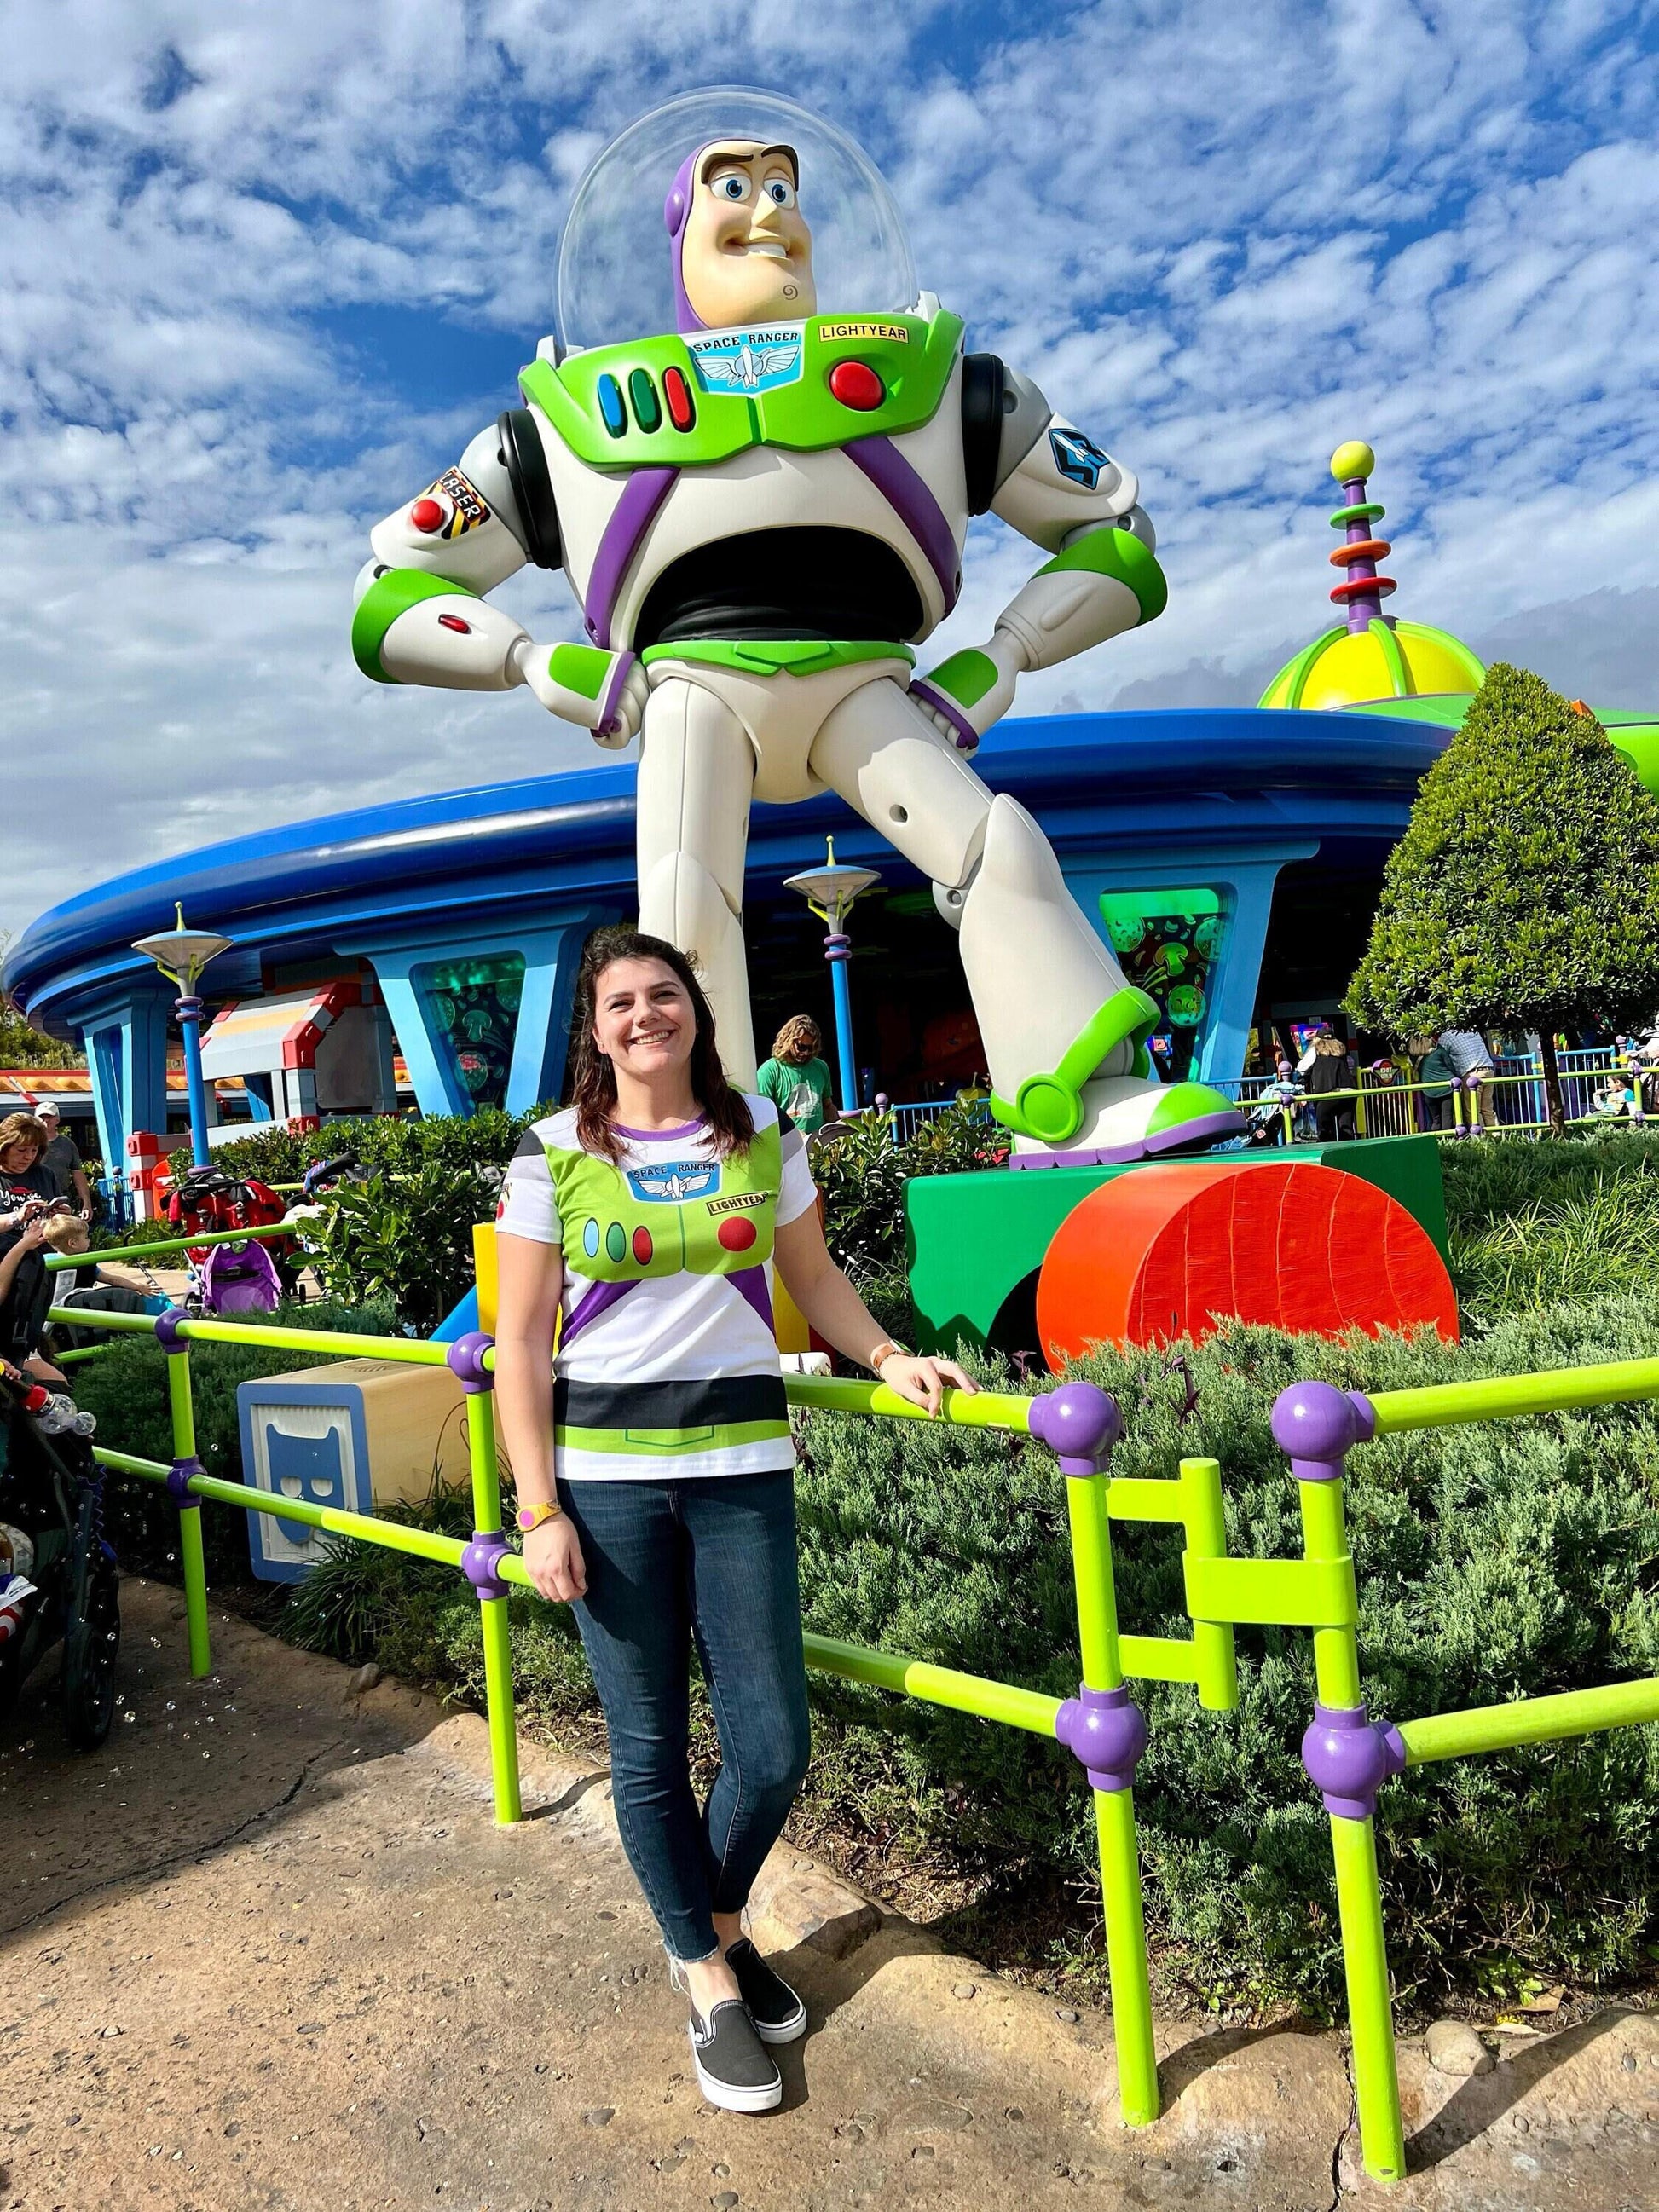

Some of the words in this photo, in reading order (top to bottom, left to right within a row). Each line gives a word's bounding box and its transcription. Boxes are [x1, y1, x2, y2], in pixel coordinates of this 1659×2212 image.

[822, 325, 906, 340] LIGHTYEAR
[692, 336, 741, 352] SPACE
[748, 332, 799, 344] RANGER
[439, 472, 481, 518] LASER
[633, 1165, 668, 1179] SPACE
[678, 1164, 715, 1172] RANGER
